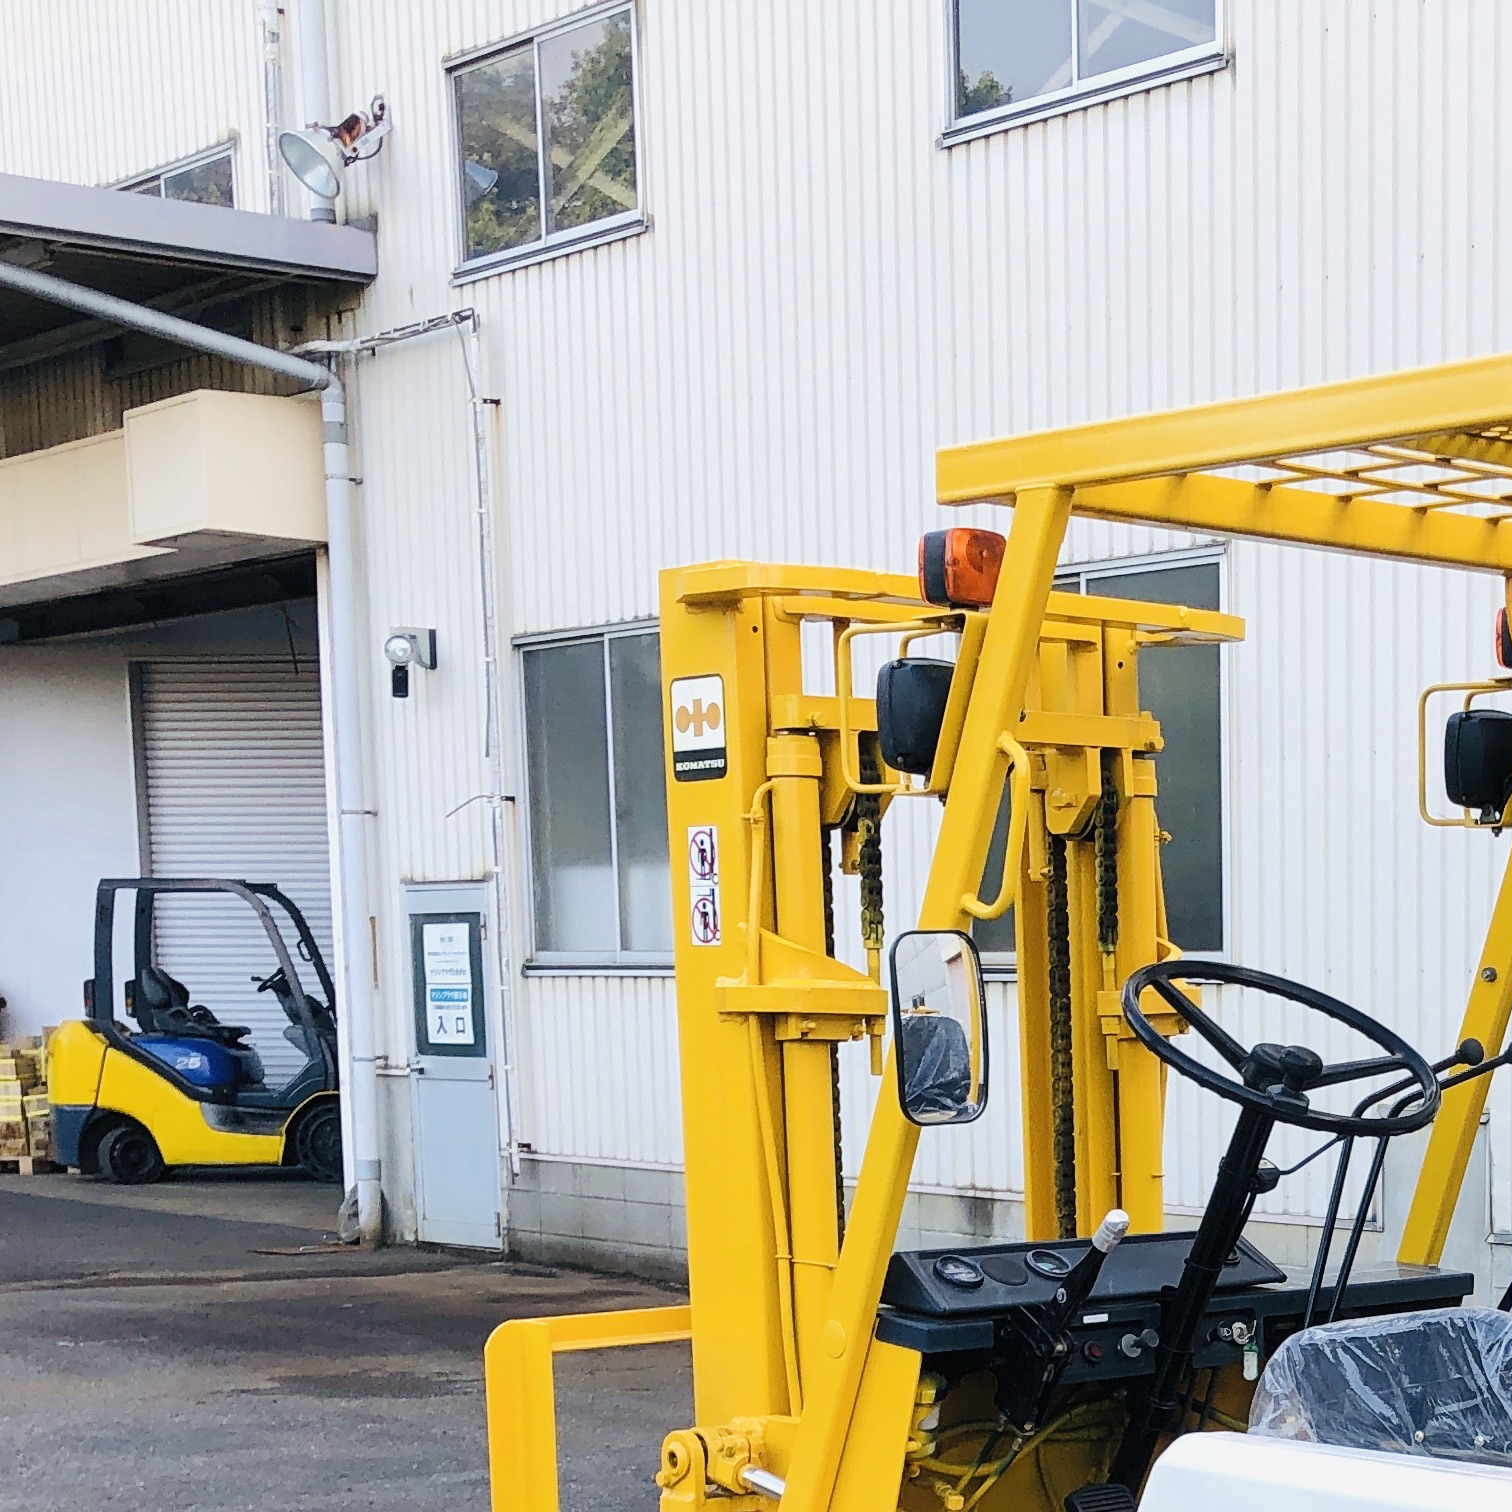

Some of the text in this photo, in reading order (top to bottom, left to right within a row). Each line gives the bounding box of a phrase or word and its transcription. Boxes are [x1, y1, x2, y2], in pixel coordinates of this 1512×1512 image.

[675, 758, 725, 771] KOMATSU
[436, 1015, 466, 1035] 入口
[175, 1056, 201, 1070] 25
